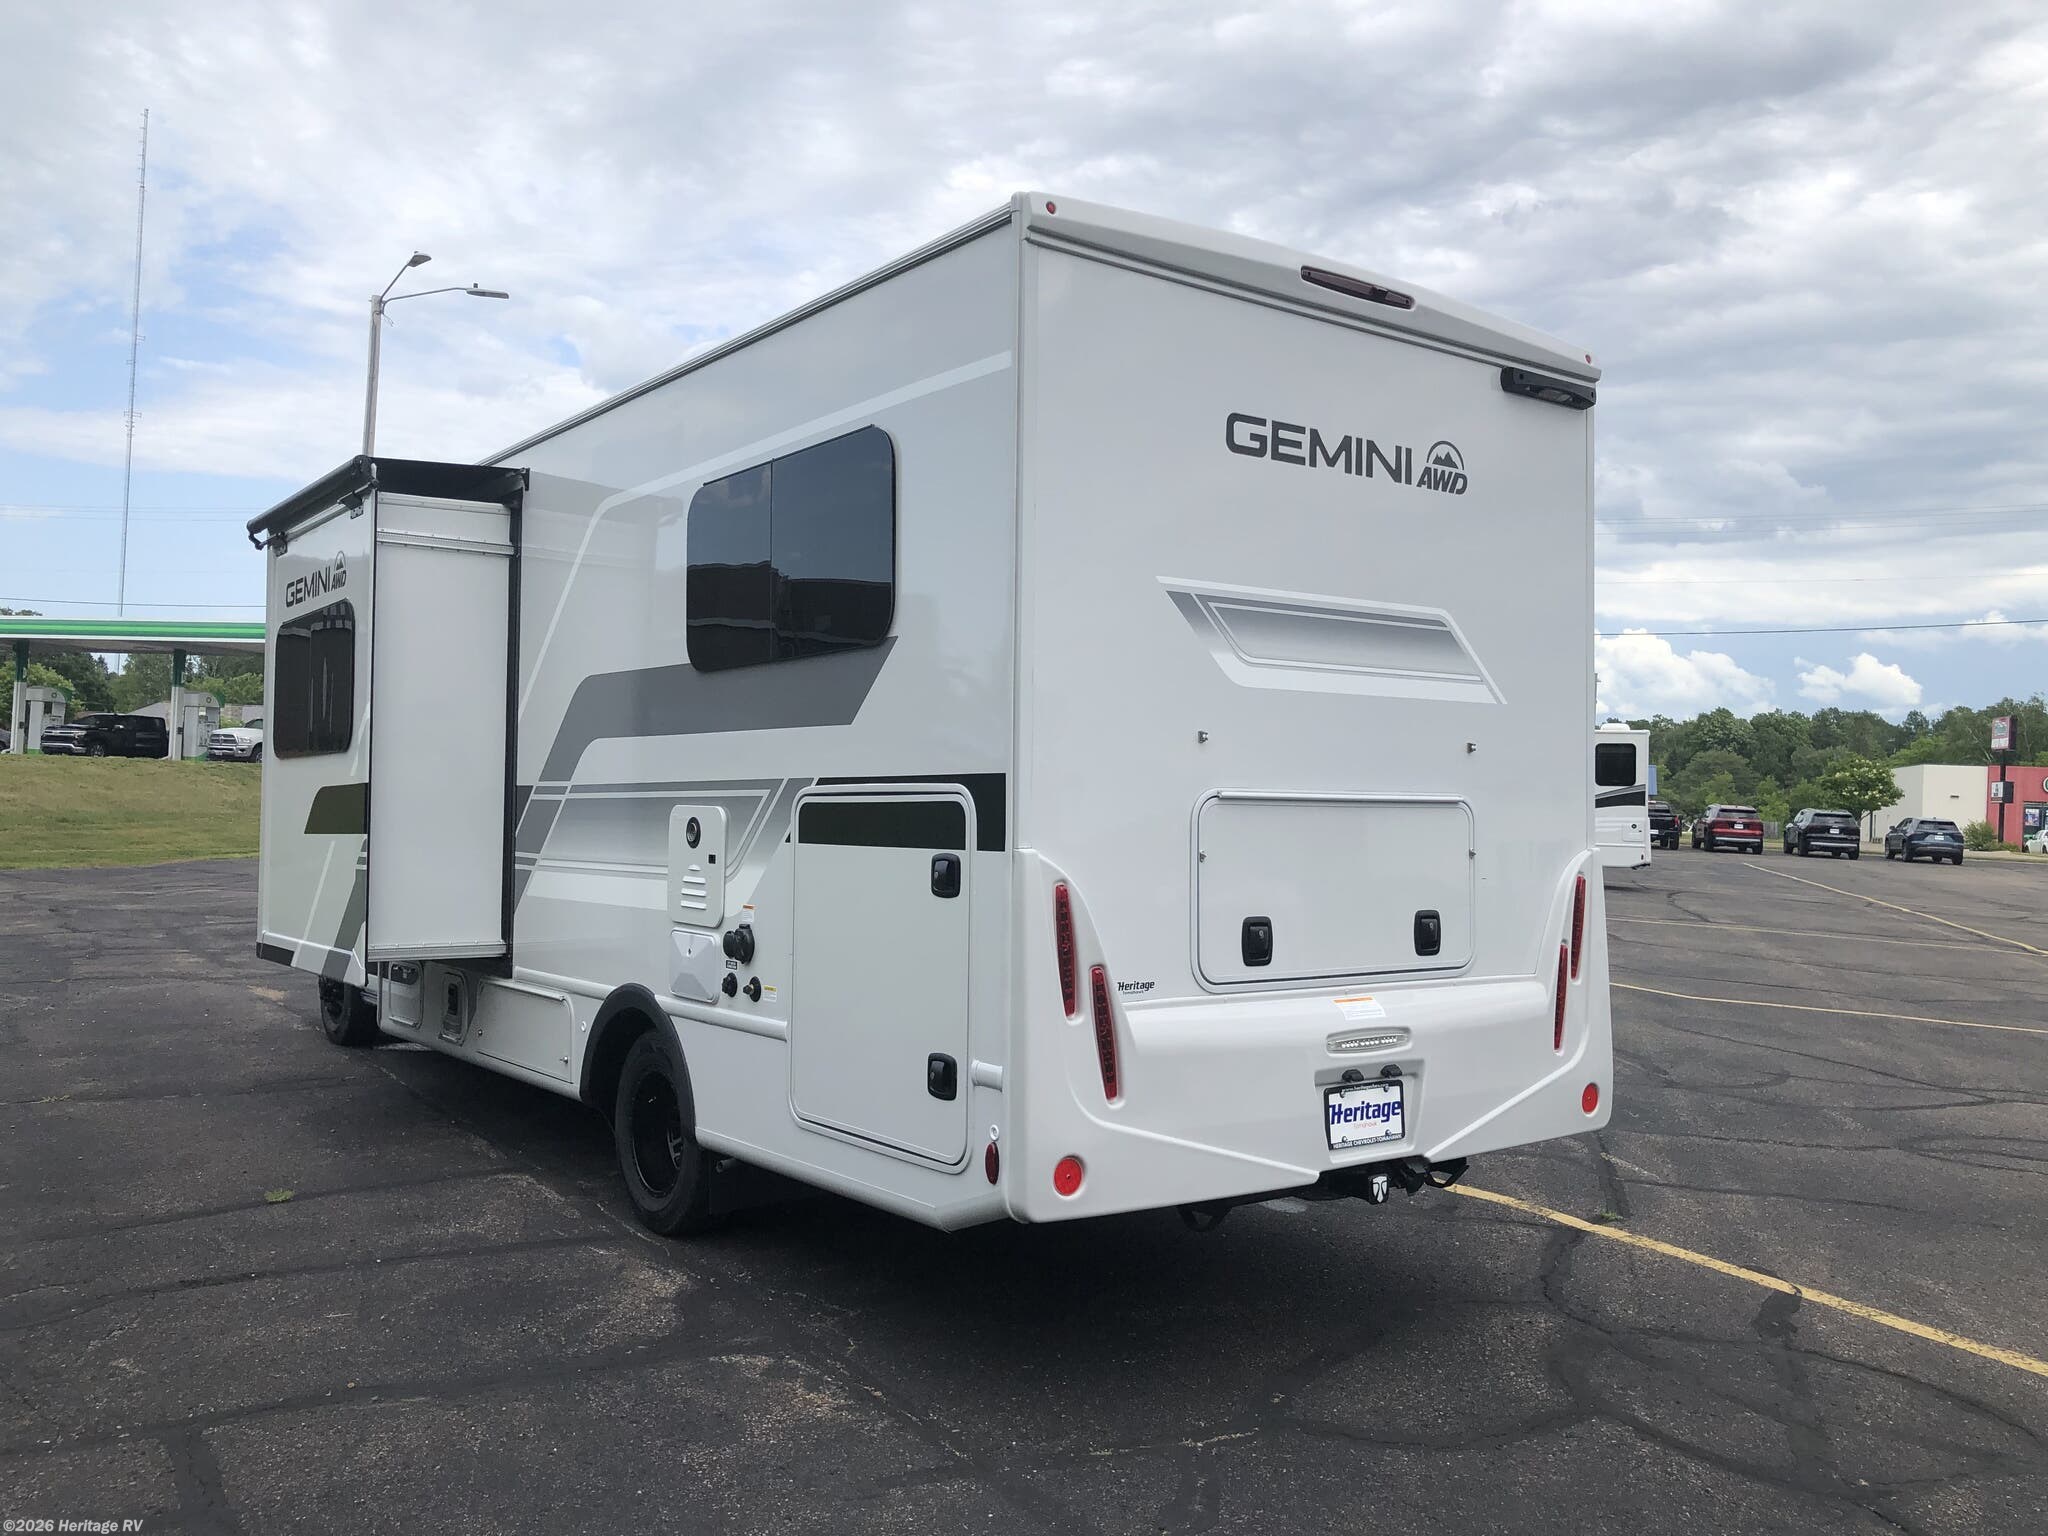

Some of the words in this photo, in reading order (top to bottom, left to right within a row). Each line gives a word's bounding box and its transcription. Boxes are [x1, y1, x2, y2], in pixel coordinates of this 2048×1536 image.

[1225, 412, 1413, 485] GEMINI
[1416, 466, 1468, 495] AWD
[285, 565, 331, 608] GEMINI
[331, 570, 347, 591] AWD
[1117, 980, 1155, 992] Heritage
[1328, 1100, 1402, 1125] Heritage
